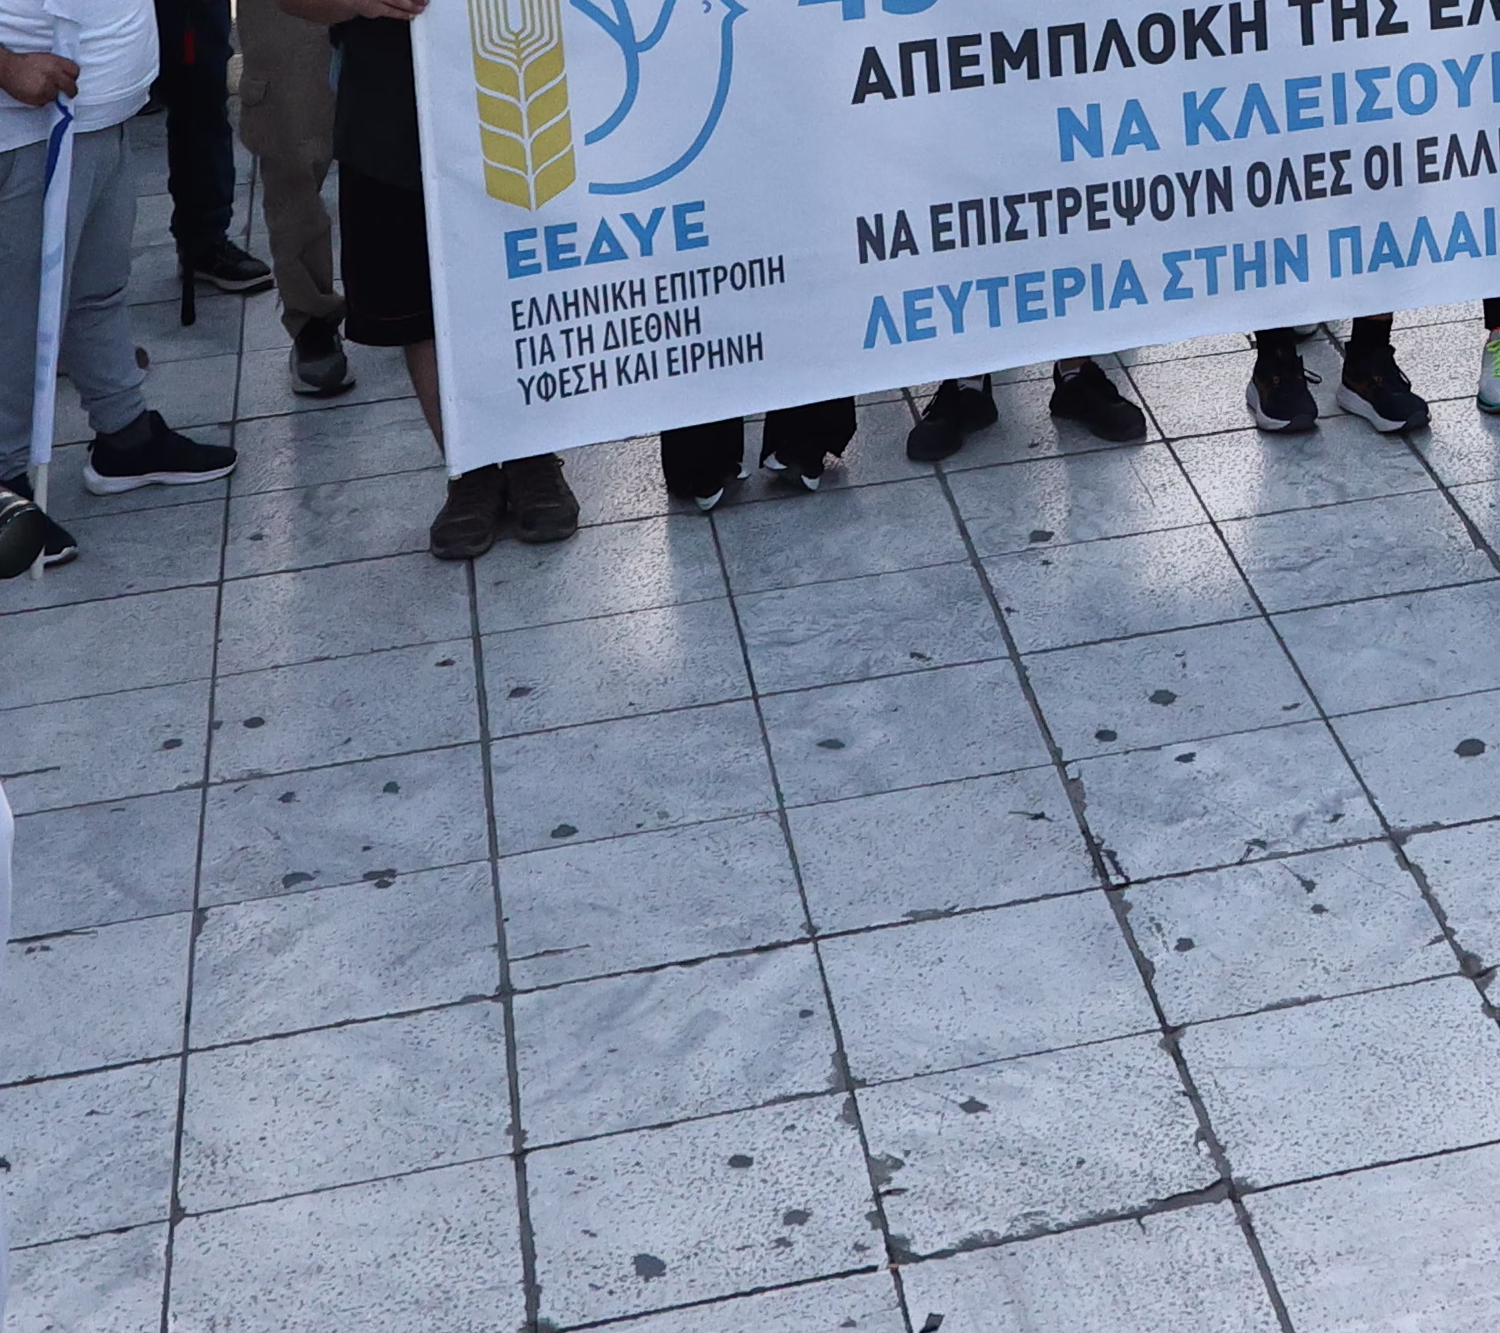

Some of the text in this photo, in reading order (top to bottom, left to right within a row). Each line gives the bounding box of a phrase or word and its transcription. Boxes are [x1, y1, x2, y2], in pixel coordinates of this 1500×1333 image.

[1056, 97, 1161, 162] ΝΑ
[504, 200, 710, 279] ΕΕΔΥΕ
[856, 209, 920, 265] ΝΑ
[929, 165, 1234, 253] ΕΠΙΣΤΡΕΨΟΥΝ
[1246, 149, 1353, 208] ΟΛΕΣ
[1364, 142, 1402, 191] ΟΙ
[510, 254, 786, 331] ΕΛΛΗΝΙΚΗ ΕΠΙΤΡΟΠΗ
[862, 258, 1149, 350] ΛΕΥΤΕΡΙΑ
[1161, 233, 1309, 302] ΣΤΗΝ
[514, 305, 702, 370] ΓΙΑ ΤΗ ΔΙΕΘΝΗ
[516, 331, 765, 406] ΥΦΕΣΗ ΚΑΙ ΕΙΡΗΝΗ
